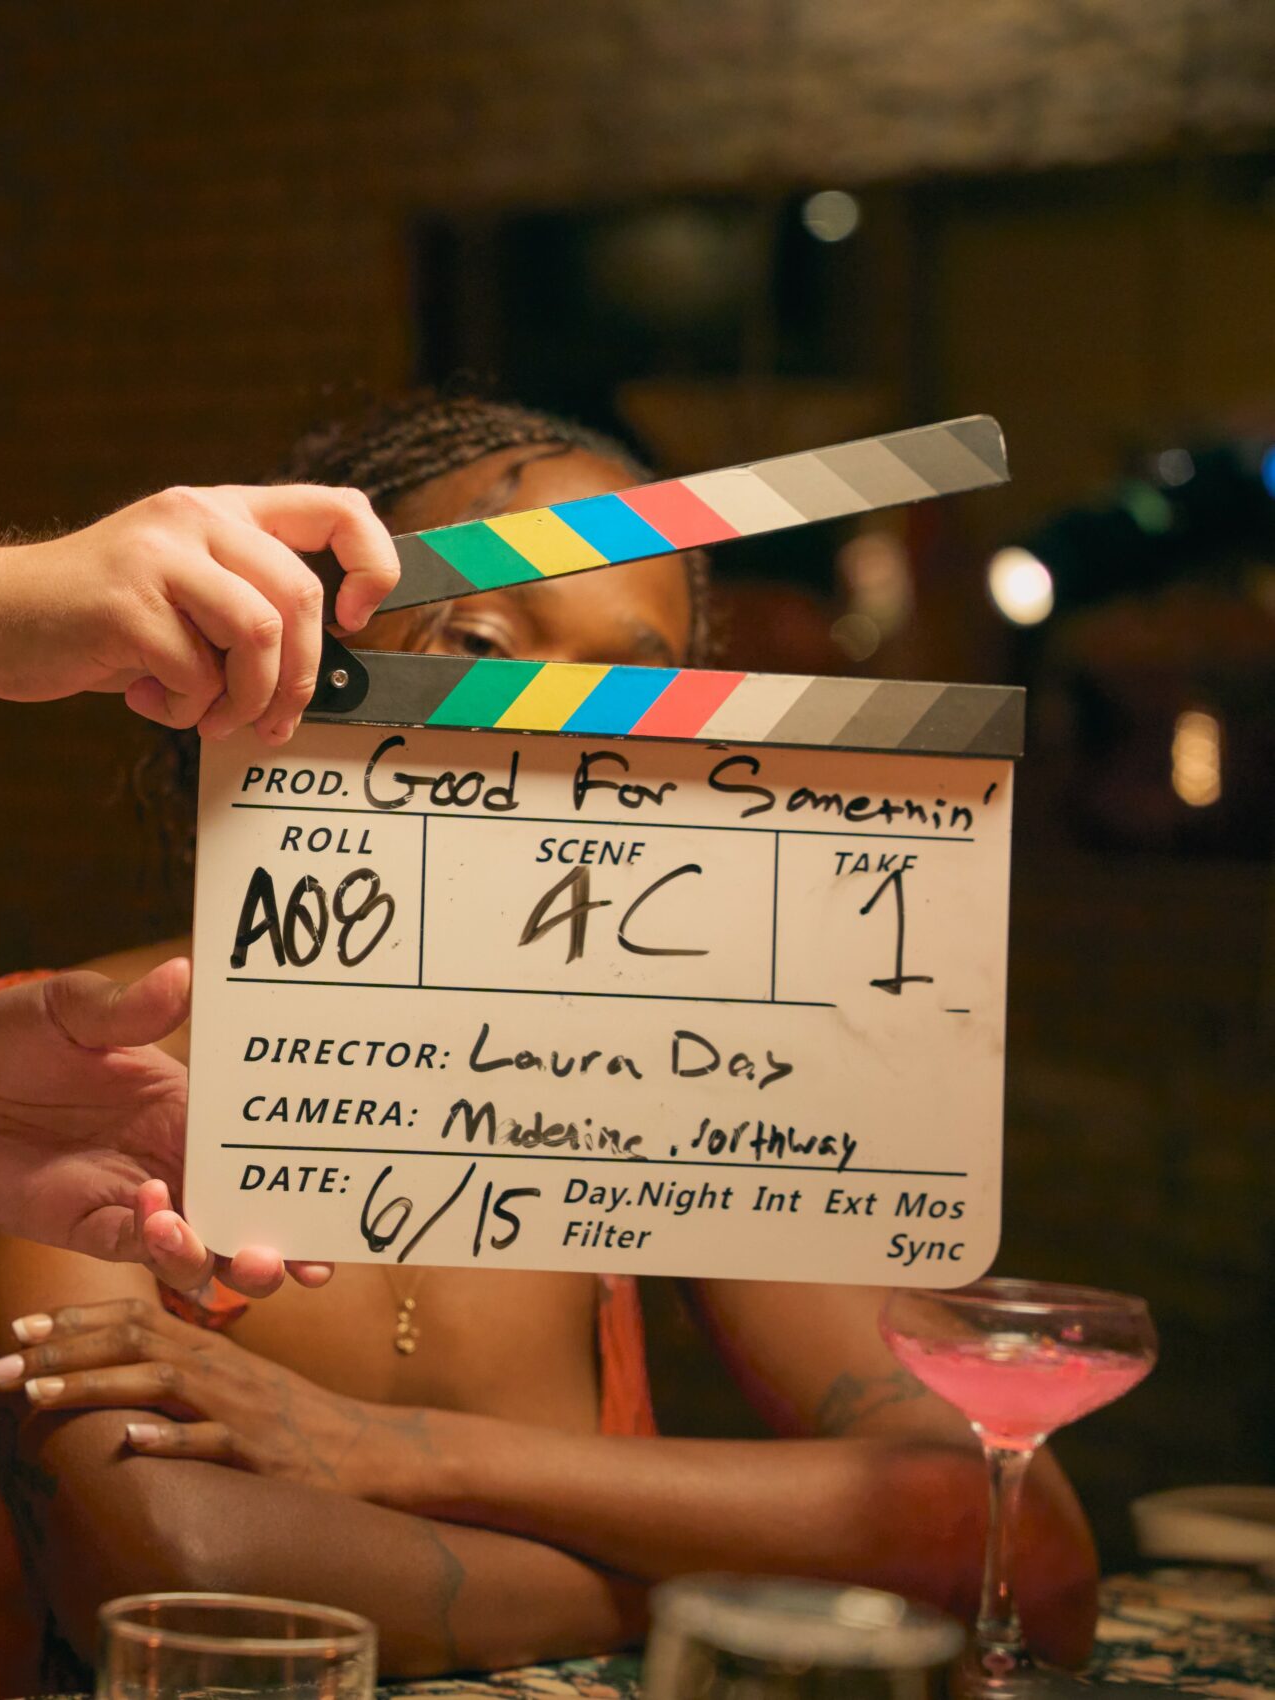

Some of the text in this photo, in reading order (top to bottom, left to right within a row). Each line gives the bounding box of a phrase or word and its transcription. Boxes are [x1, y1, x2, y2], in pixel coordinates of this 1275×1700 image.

[241, 766, 349, 797] PROD.
[364, 735, 520, 810] Good
[573, 751, 677, 811] For
[280, 826, 373, 855] ROLL
[535, 838, 646, 865] SCENE
[834, 851, 918, 876] TAKE
[230, 866, 396, 969] A08
[859, 869, 934, 995] 1
[243, 1036, 450, 1069] DIRECTOR:
[469, 1023, 793, 1090] Laura Day
[241, 1095, 418, 1127] CAMERA:
[239, 1165, 350, 1194] DATE:
[360, 1162, 541, 1263] 6/15
[752, 1185, 802, 1213] Int
[825, 1189, 877, 1216] Ext
[894, 1193, 966, 1220] Mos
[562, 1221, 651, 1249] Filter
[886, 1234, 965, 1266] Sync
